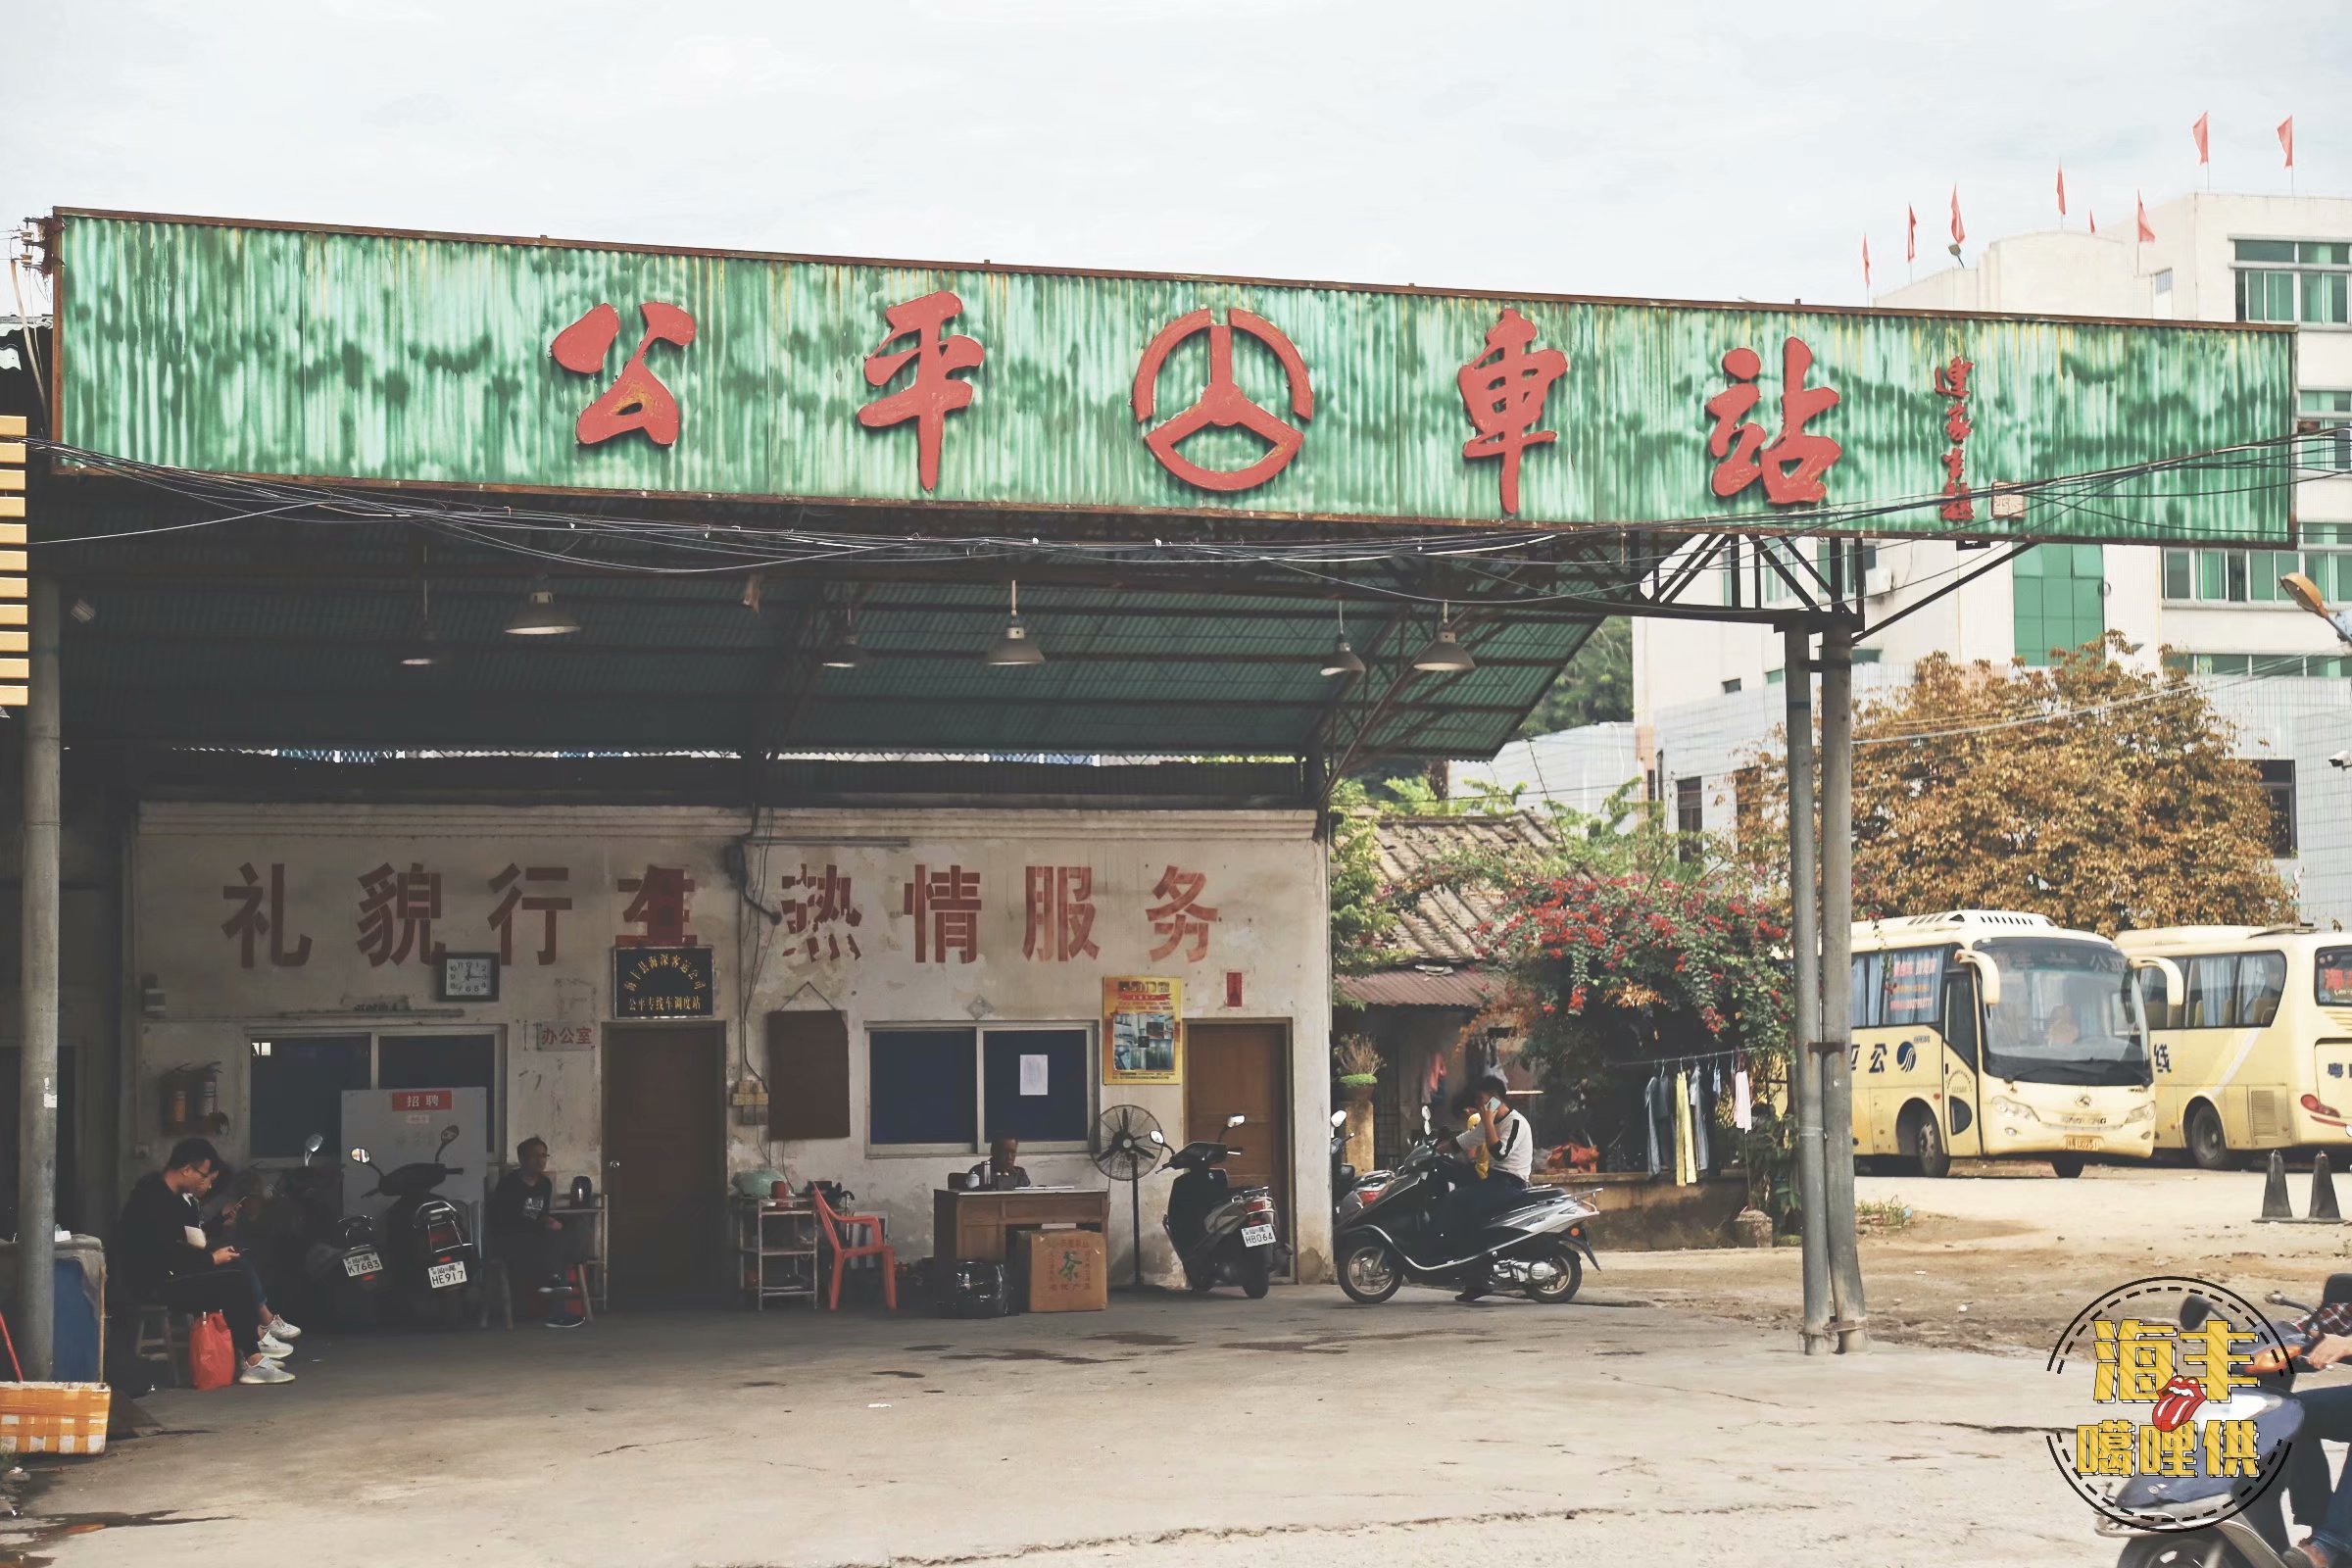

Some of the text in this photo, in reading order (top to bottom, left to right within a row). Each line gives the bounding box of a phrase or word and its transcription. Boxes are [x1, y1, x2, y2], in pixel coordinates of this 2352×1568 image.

[549, 291, 1842, 514] 公平 車站
[781, 862, 1218, 964] 热情服务
[541, 1026, 592, 1046] 办公室
[407, 1095, 439, 1107] 招聘
[347, 1259, 380, 1274] K7683
[431, 1270, 465, 1286] HE917
